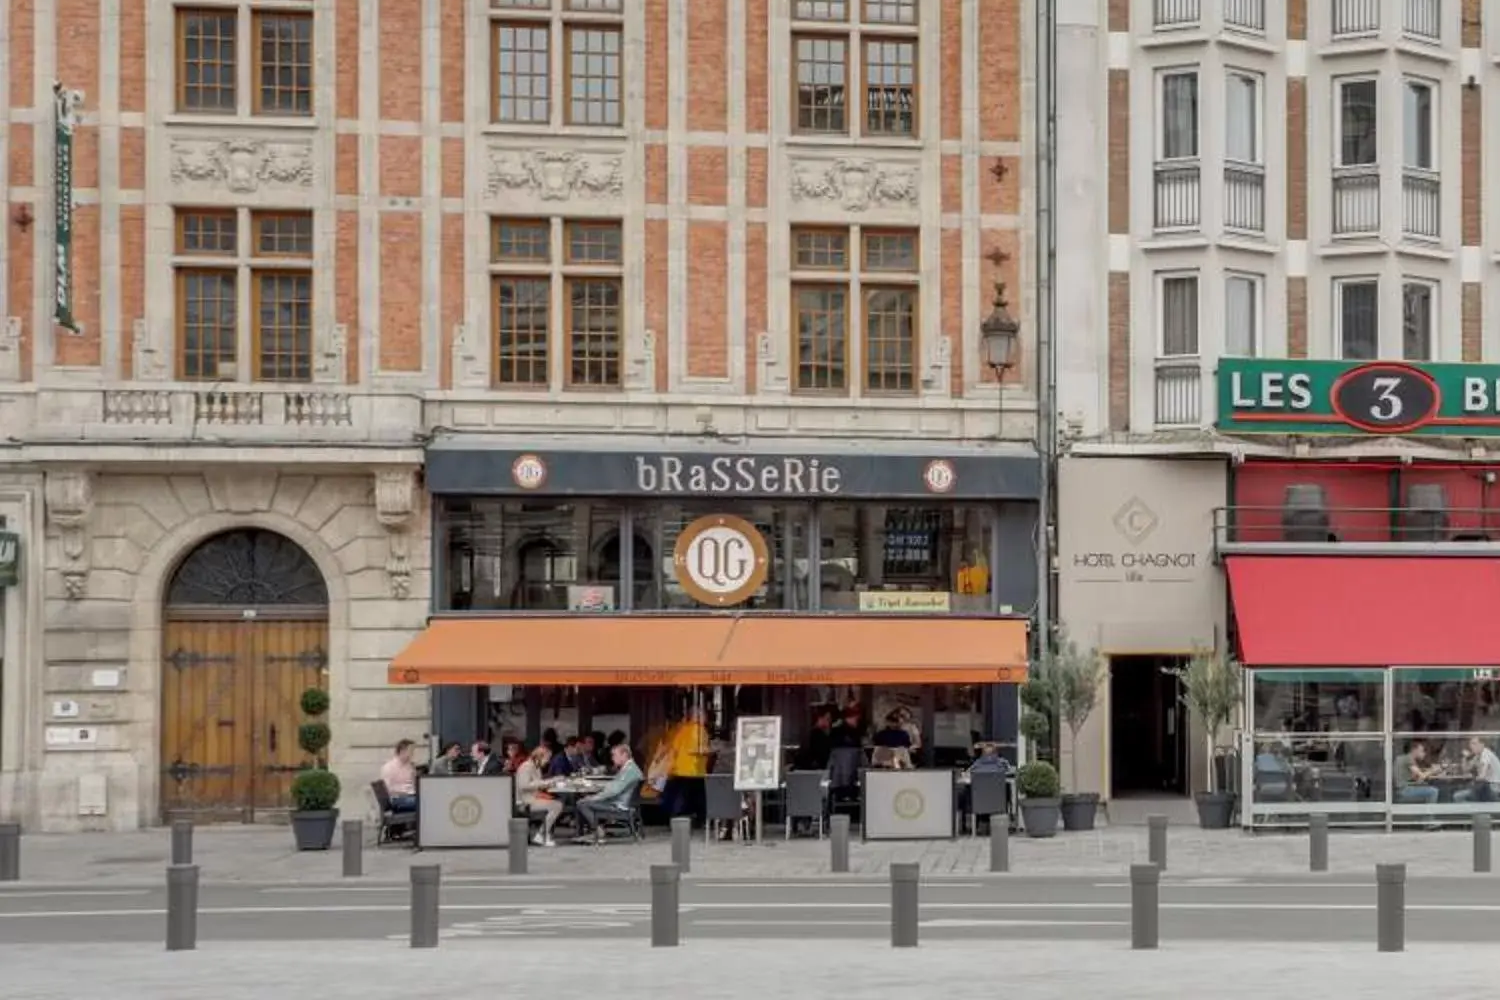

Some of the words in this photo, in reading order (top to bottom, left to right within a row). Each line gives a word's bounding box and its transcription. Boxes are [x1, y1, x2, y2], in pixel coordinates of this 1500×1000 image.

[1231, 372, 1312, 408] LES
[1370, 377, 1403, 420] 3
[635, 456, 841, 493] bRaSSeRie
[697, 537, 748, 586] QG
[1074, 554, 1115, 567] HOTEL
[1121, 553, 1196, 567] CHAGNOT
